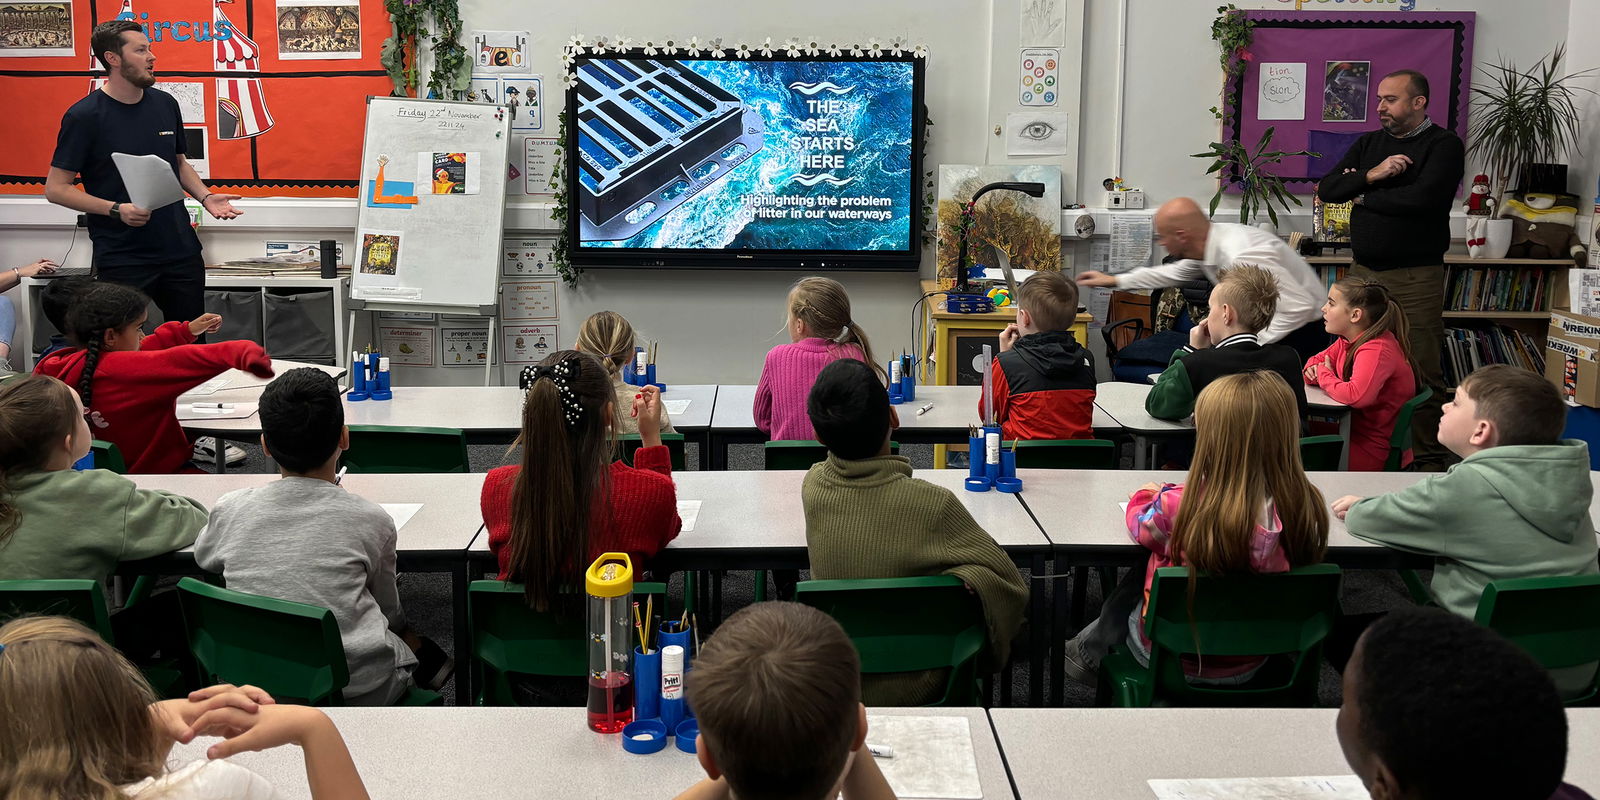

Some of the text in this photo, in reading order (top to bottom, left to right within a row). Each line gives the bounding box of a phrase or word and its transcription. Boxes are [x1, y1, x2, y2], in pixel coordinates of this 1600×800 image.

[475, 40, 527, 67] bed
[1269, 66, 1291, 75] tion
[1270, 85, 1292, 95] sion
[806, 100, 840, 114] THE
[398, 107, 426, 122] Friday
[805, 118, 839, 132] SEA
[791, 136, 855, 150] STARTS
[800, 154, 845, 168] HERE
[741, 194, 892, 207] Highlighting the problem
[745, 207, 892, 220] of litter in our waterways
[664, 676, 679, 685] Pritt
